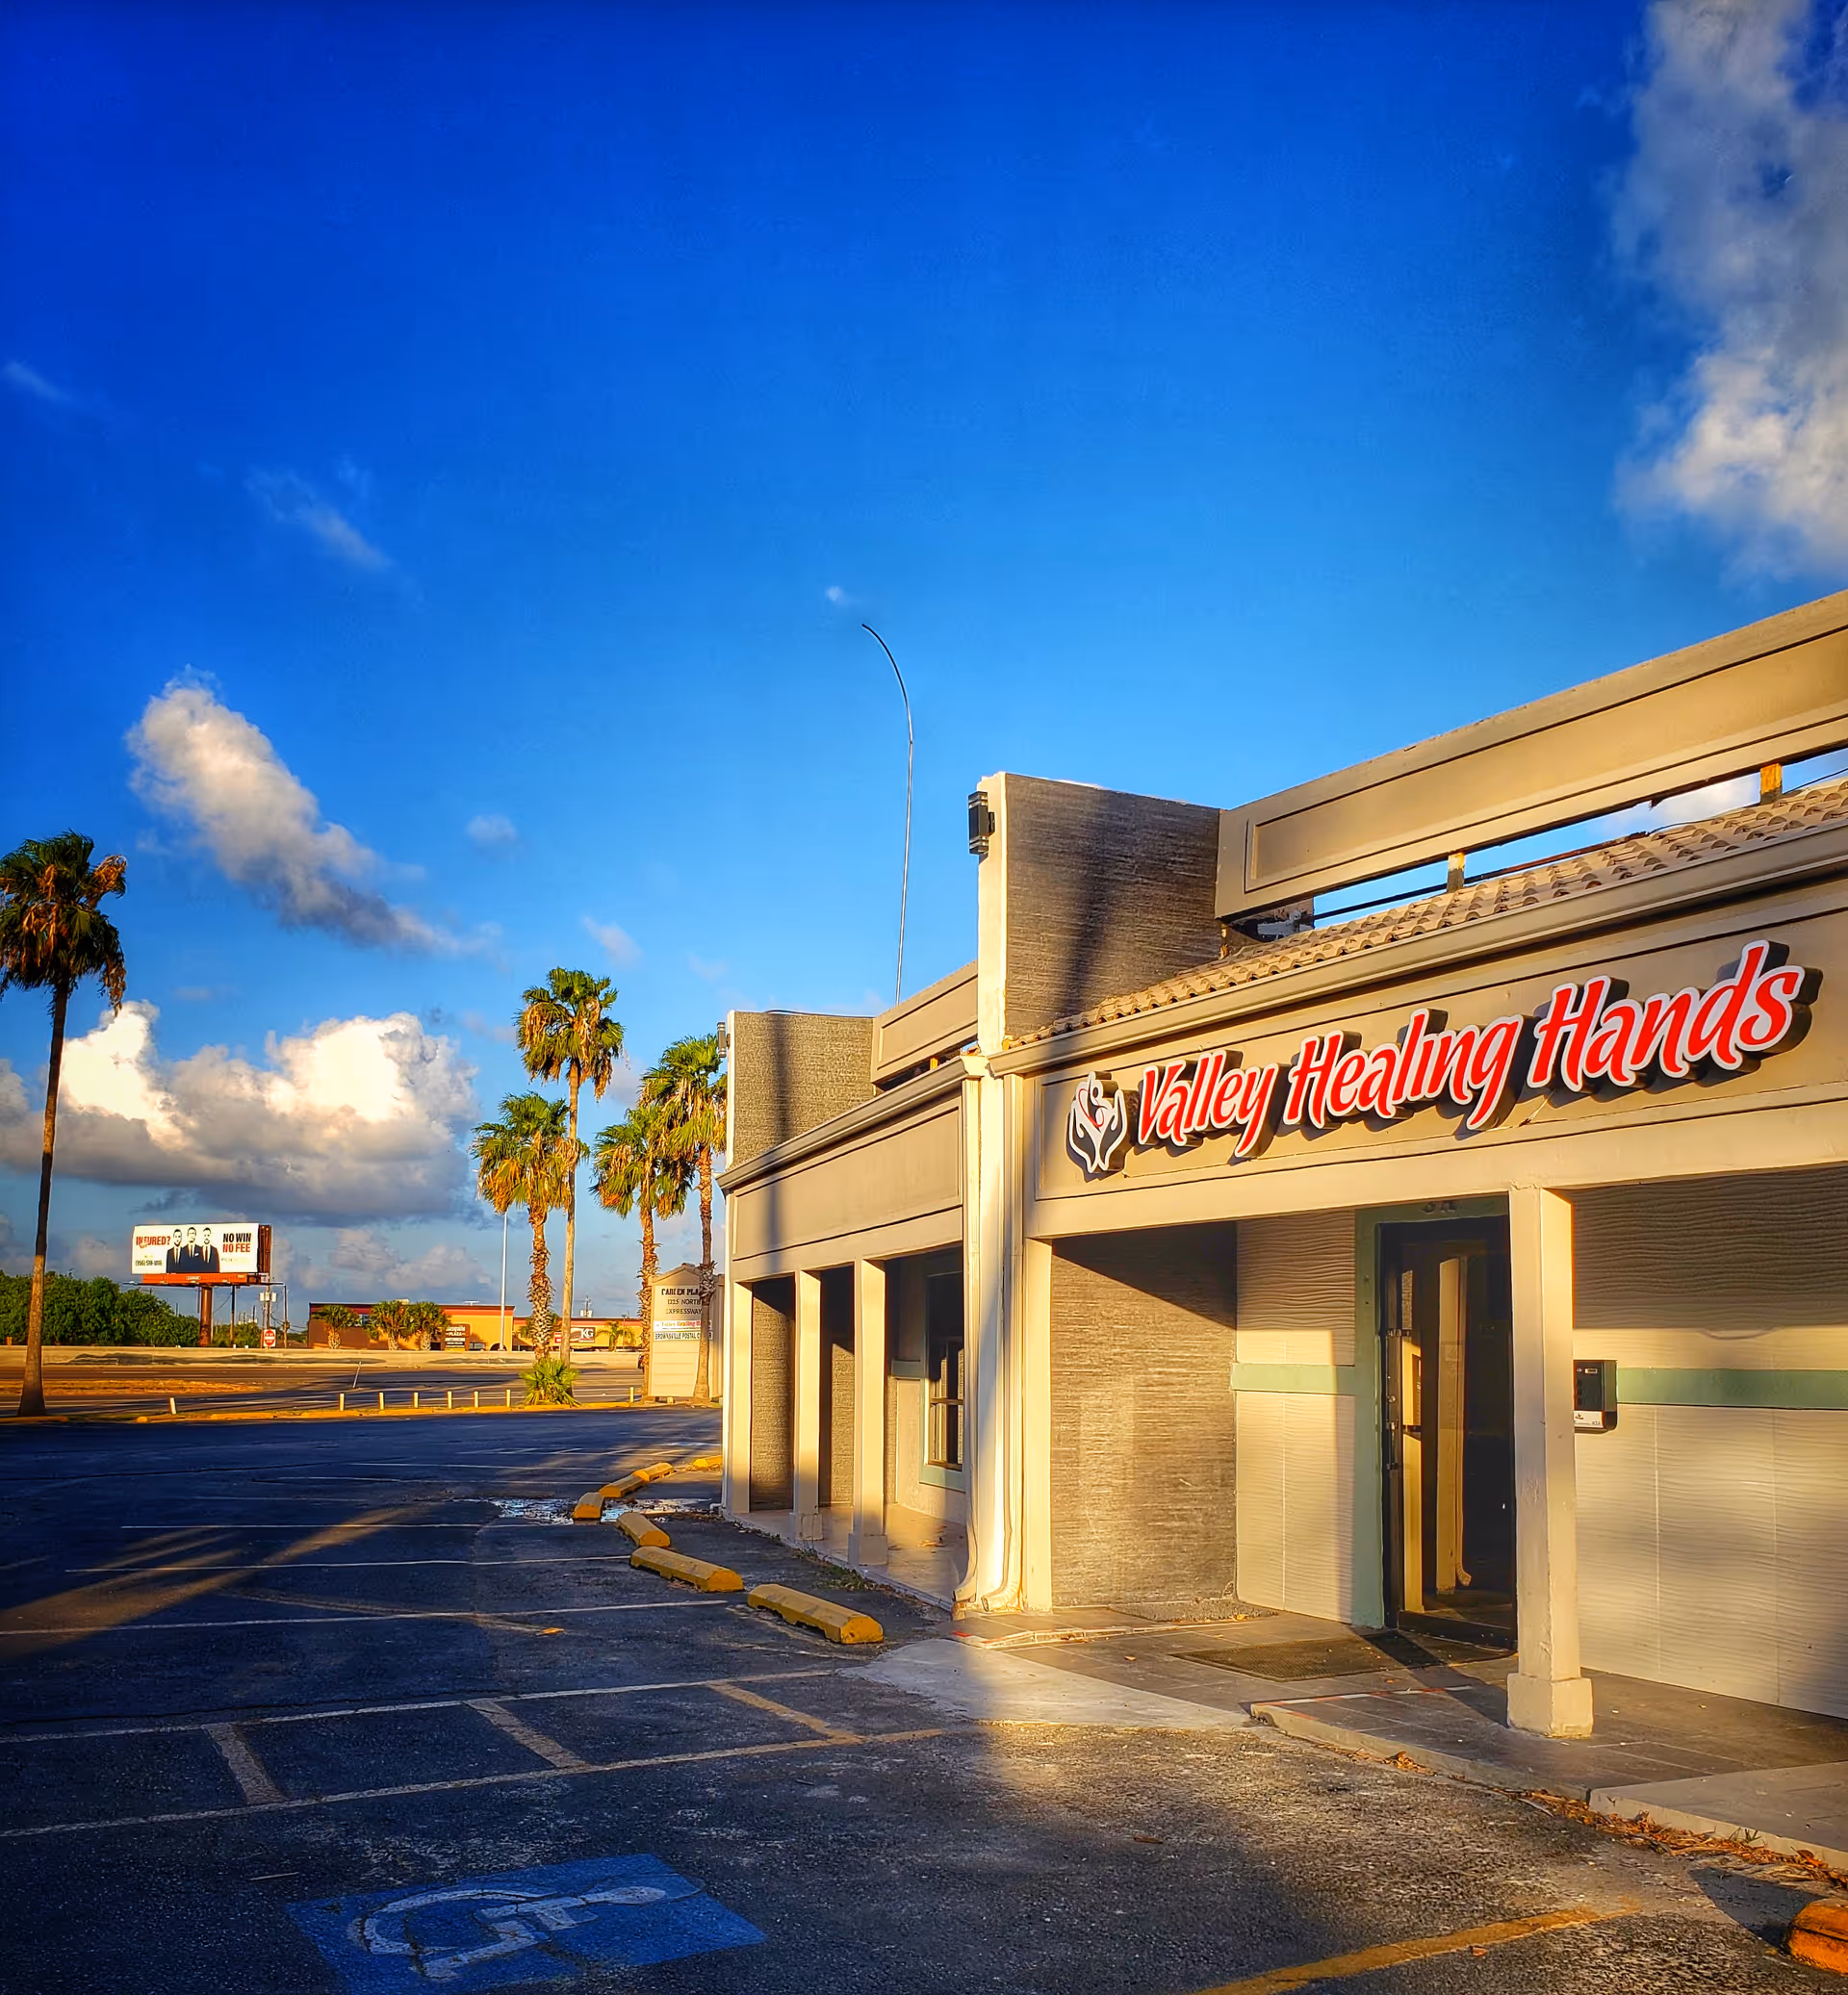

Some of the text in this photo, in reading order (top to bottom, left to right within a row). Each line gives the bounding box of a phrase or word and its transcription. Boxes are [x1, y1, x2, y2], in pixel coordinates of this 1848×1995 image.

[1139, 940, 1804, 1157] Valley Healing Hands
[222, 1232, 251, 1242] NO WIN
[222, 1242, 250, 1253] NO FEE
